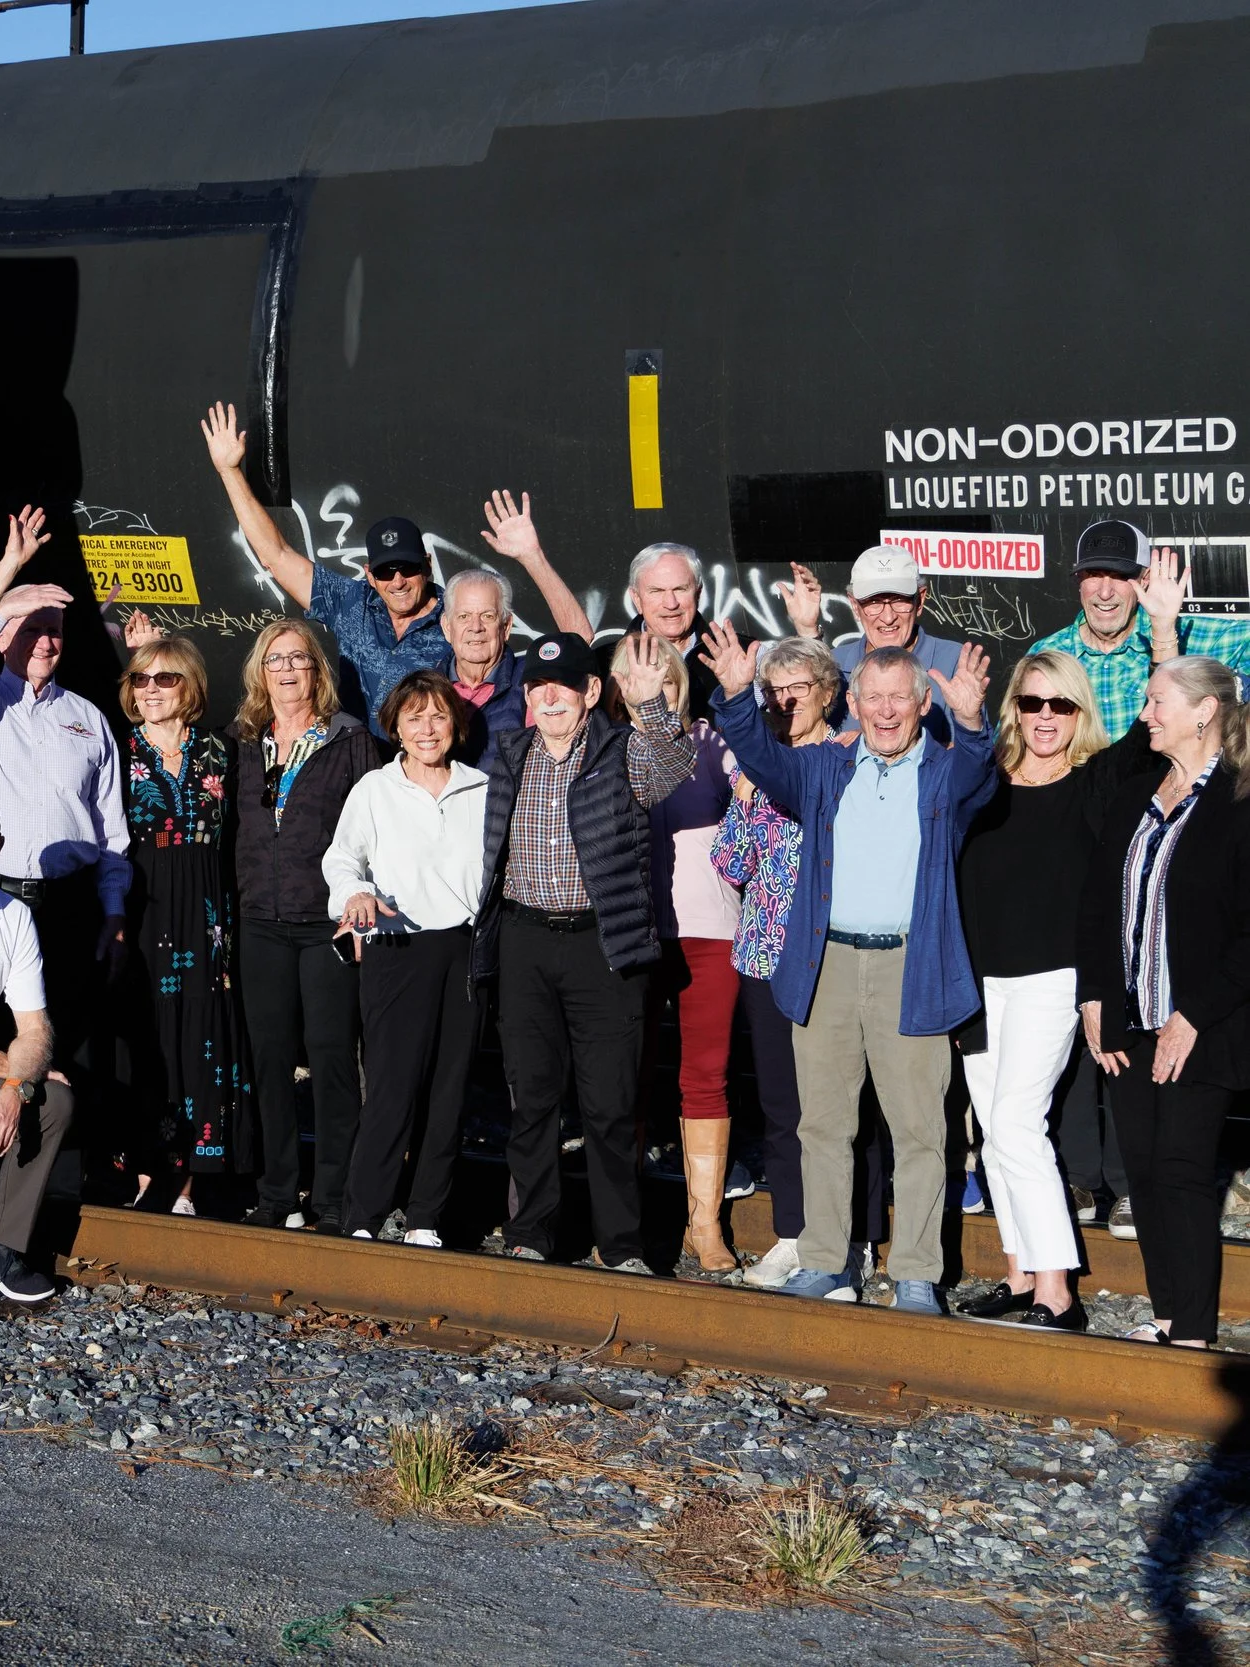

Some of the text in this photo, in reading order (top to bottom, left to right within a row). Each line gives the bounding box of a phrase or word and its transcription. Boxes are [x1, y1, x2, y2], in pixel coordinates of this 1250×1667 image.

[884, 417, 1238, 463] NON-ODORIZED
[888, 471, 1250, 509] LIQUEFIED PETROLEUM G
[110, 540, 168, 551] EMERGENCY
[884, 537, 1041, 572] ON-ODORIZED
[132, 560, 145, 570] OR
[146, 560, 172, 570] NIGHT
[1188, 603, 1201, 613] 03
[1224, 603, 1237, 612] 14
